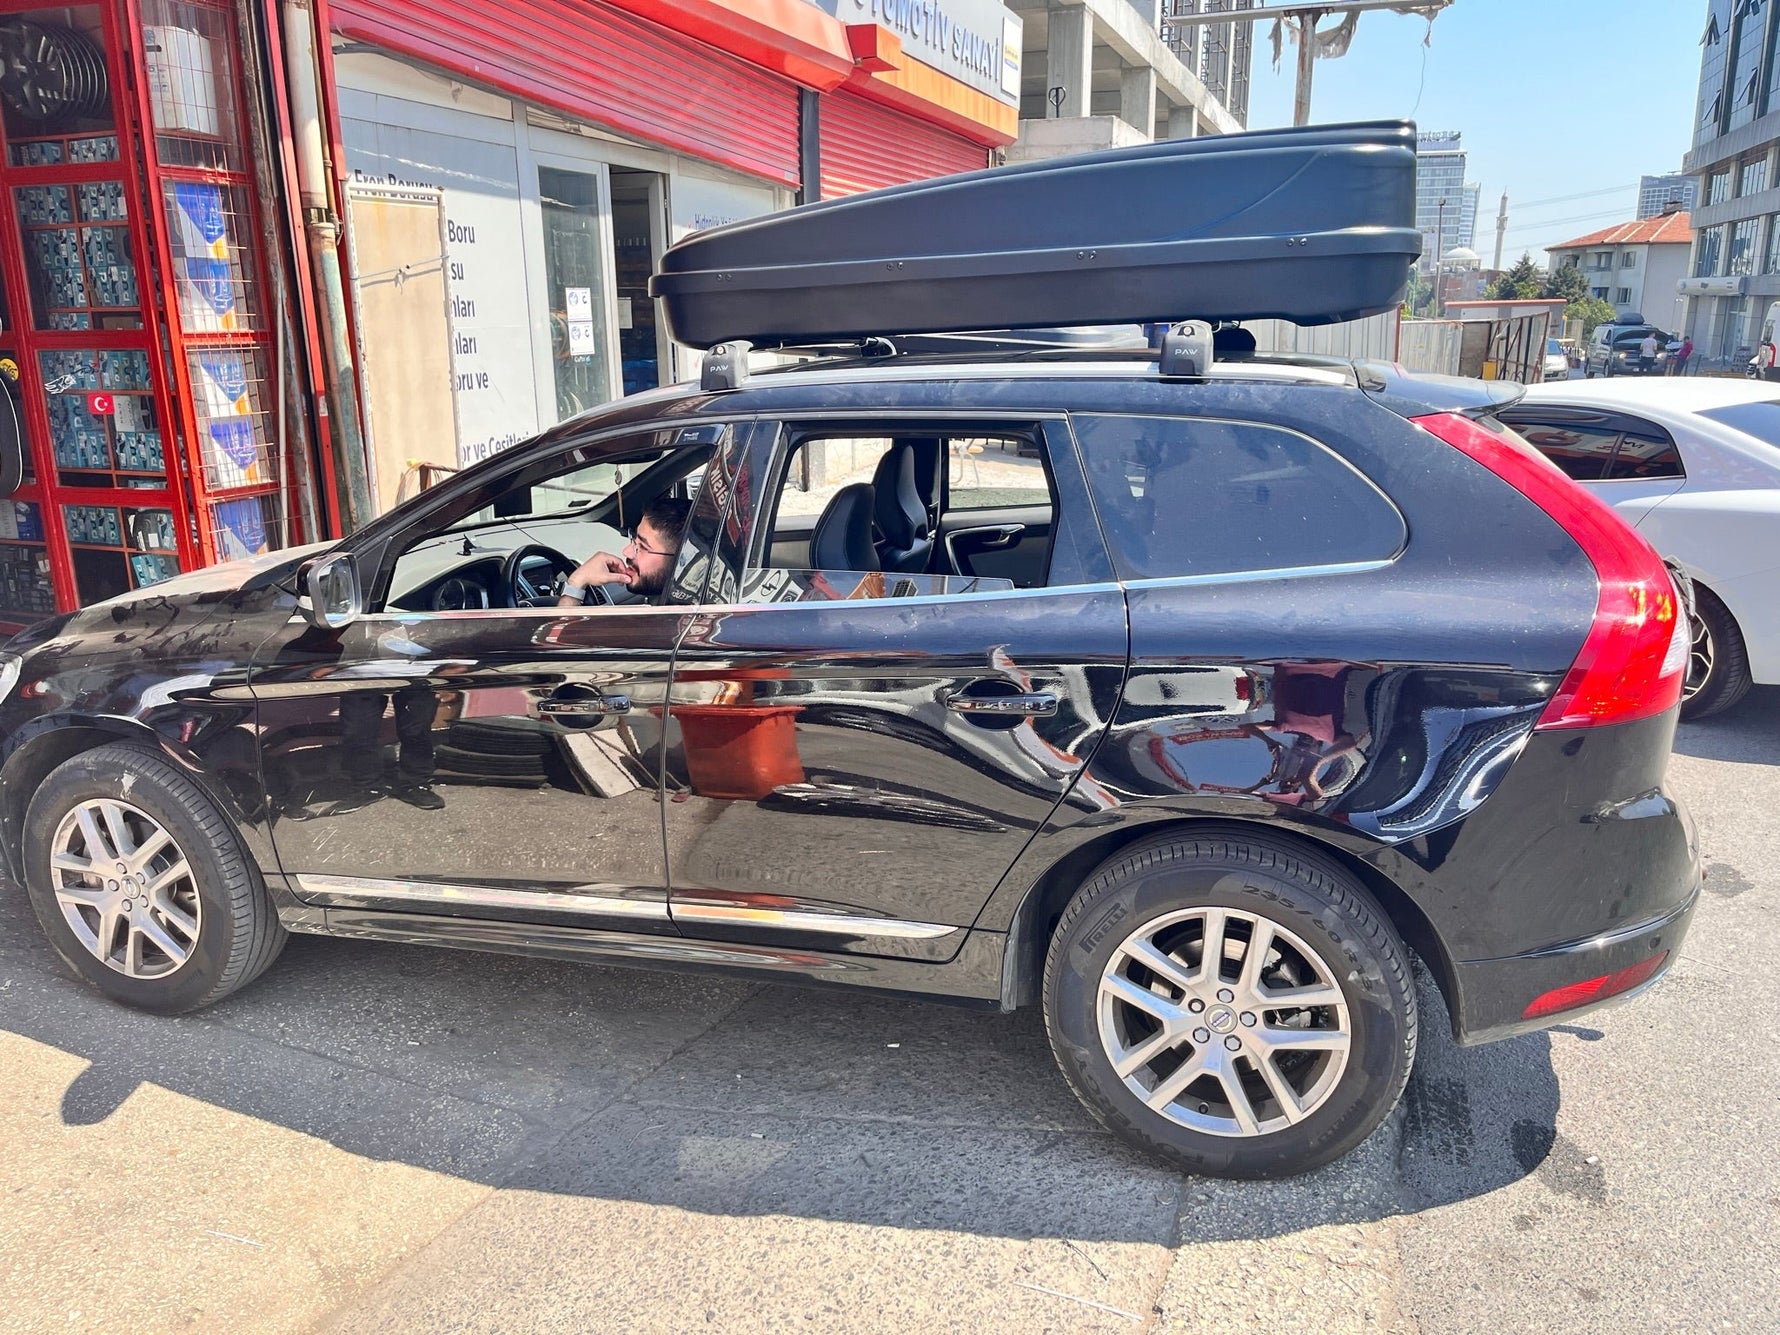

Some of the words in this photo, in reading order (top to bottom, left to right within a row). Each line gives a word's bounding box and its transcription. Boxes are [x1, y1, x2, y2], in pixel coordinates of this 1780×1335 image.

[952, 22, 999, 83] SANAYİ
[447, 220, 475, 243] Boru
[455, 332, 477, 354] ları
[710, 364, 729, 373] PAW
[476, 371, 489, 389] ve
[474, 442, 487, 460] ve
[1079, 902, 1128, 954] PIRELLI
